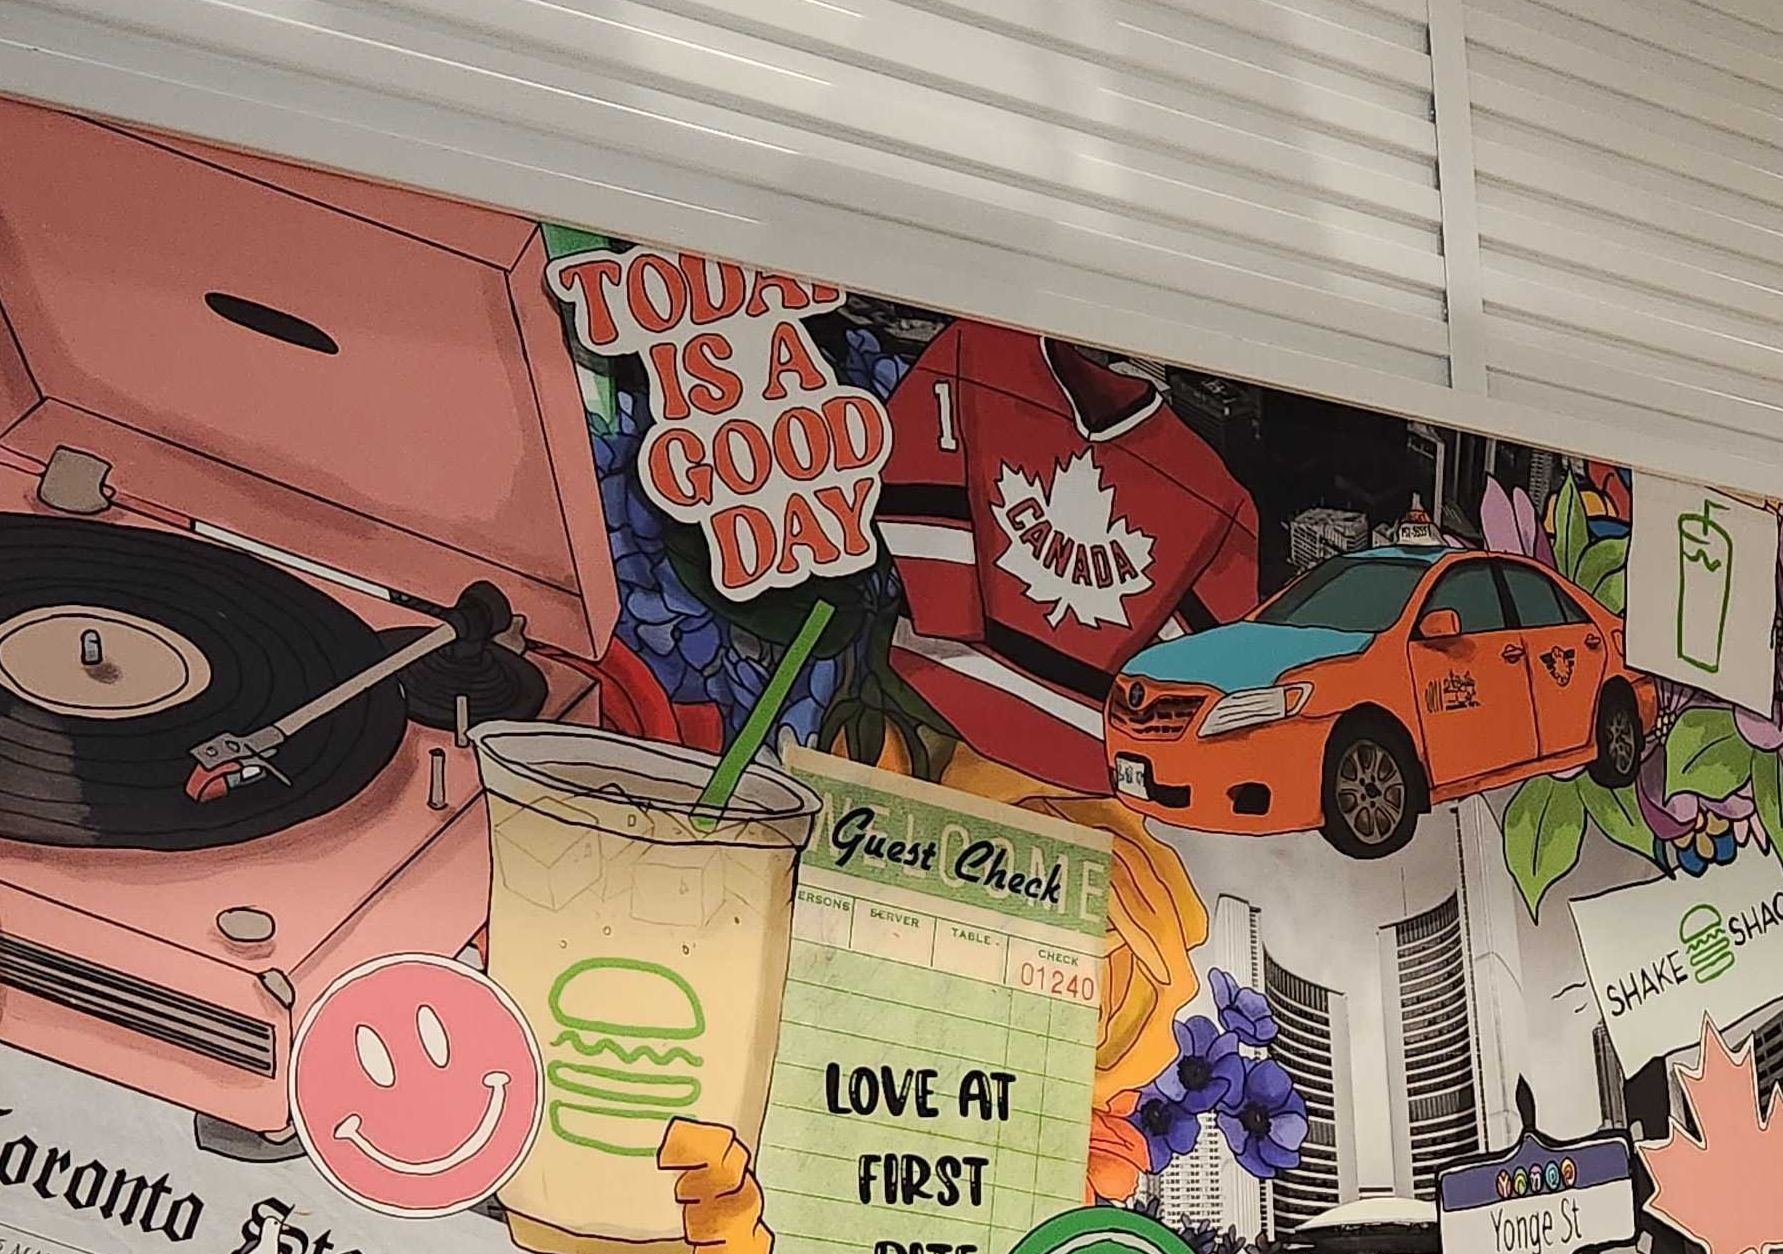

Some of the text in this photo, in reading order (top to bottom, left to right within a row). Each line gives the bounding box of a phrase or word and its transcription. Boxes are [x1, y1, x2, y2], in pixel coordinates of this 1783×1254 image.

[560, 252, 840, 346] TODA
[650, 322, 827, 420] IS A
[934, 380, 959, 452] 1
[648, 394, 884, 507] GOOD
[708, 477, 876, 589] DAY
[1004, 496, 1137, 591] CANADA
[831, 806, 1063, 905] Guest Check
[797, 889, 851, 913] ERSONS
[869, 907, 921, 929] SERVER
[950, 925, 993, 947] TABLE
[1037, 948, 1080, 968] CHECK
[1019, 961, 1096, 1002] 01240
[1605, 951, 1689, 1019] SHAKE
[824, 1061, 1018, 1122] LOVE AT
[0, 1107, 205, 1242] oronto
[856, 1154, 991, 1208] FIRST
[1559, 1196, 1583, 1242] St
